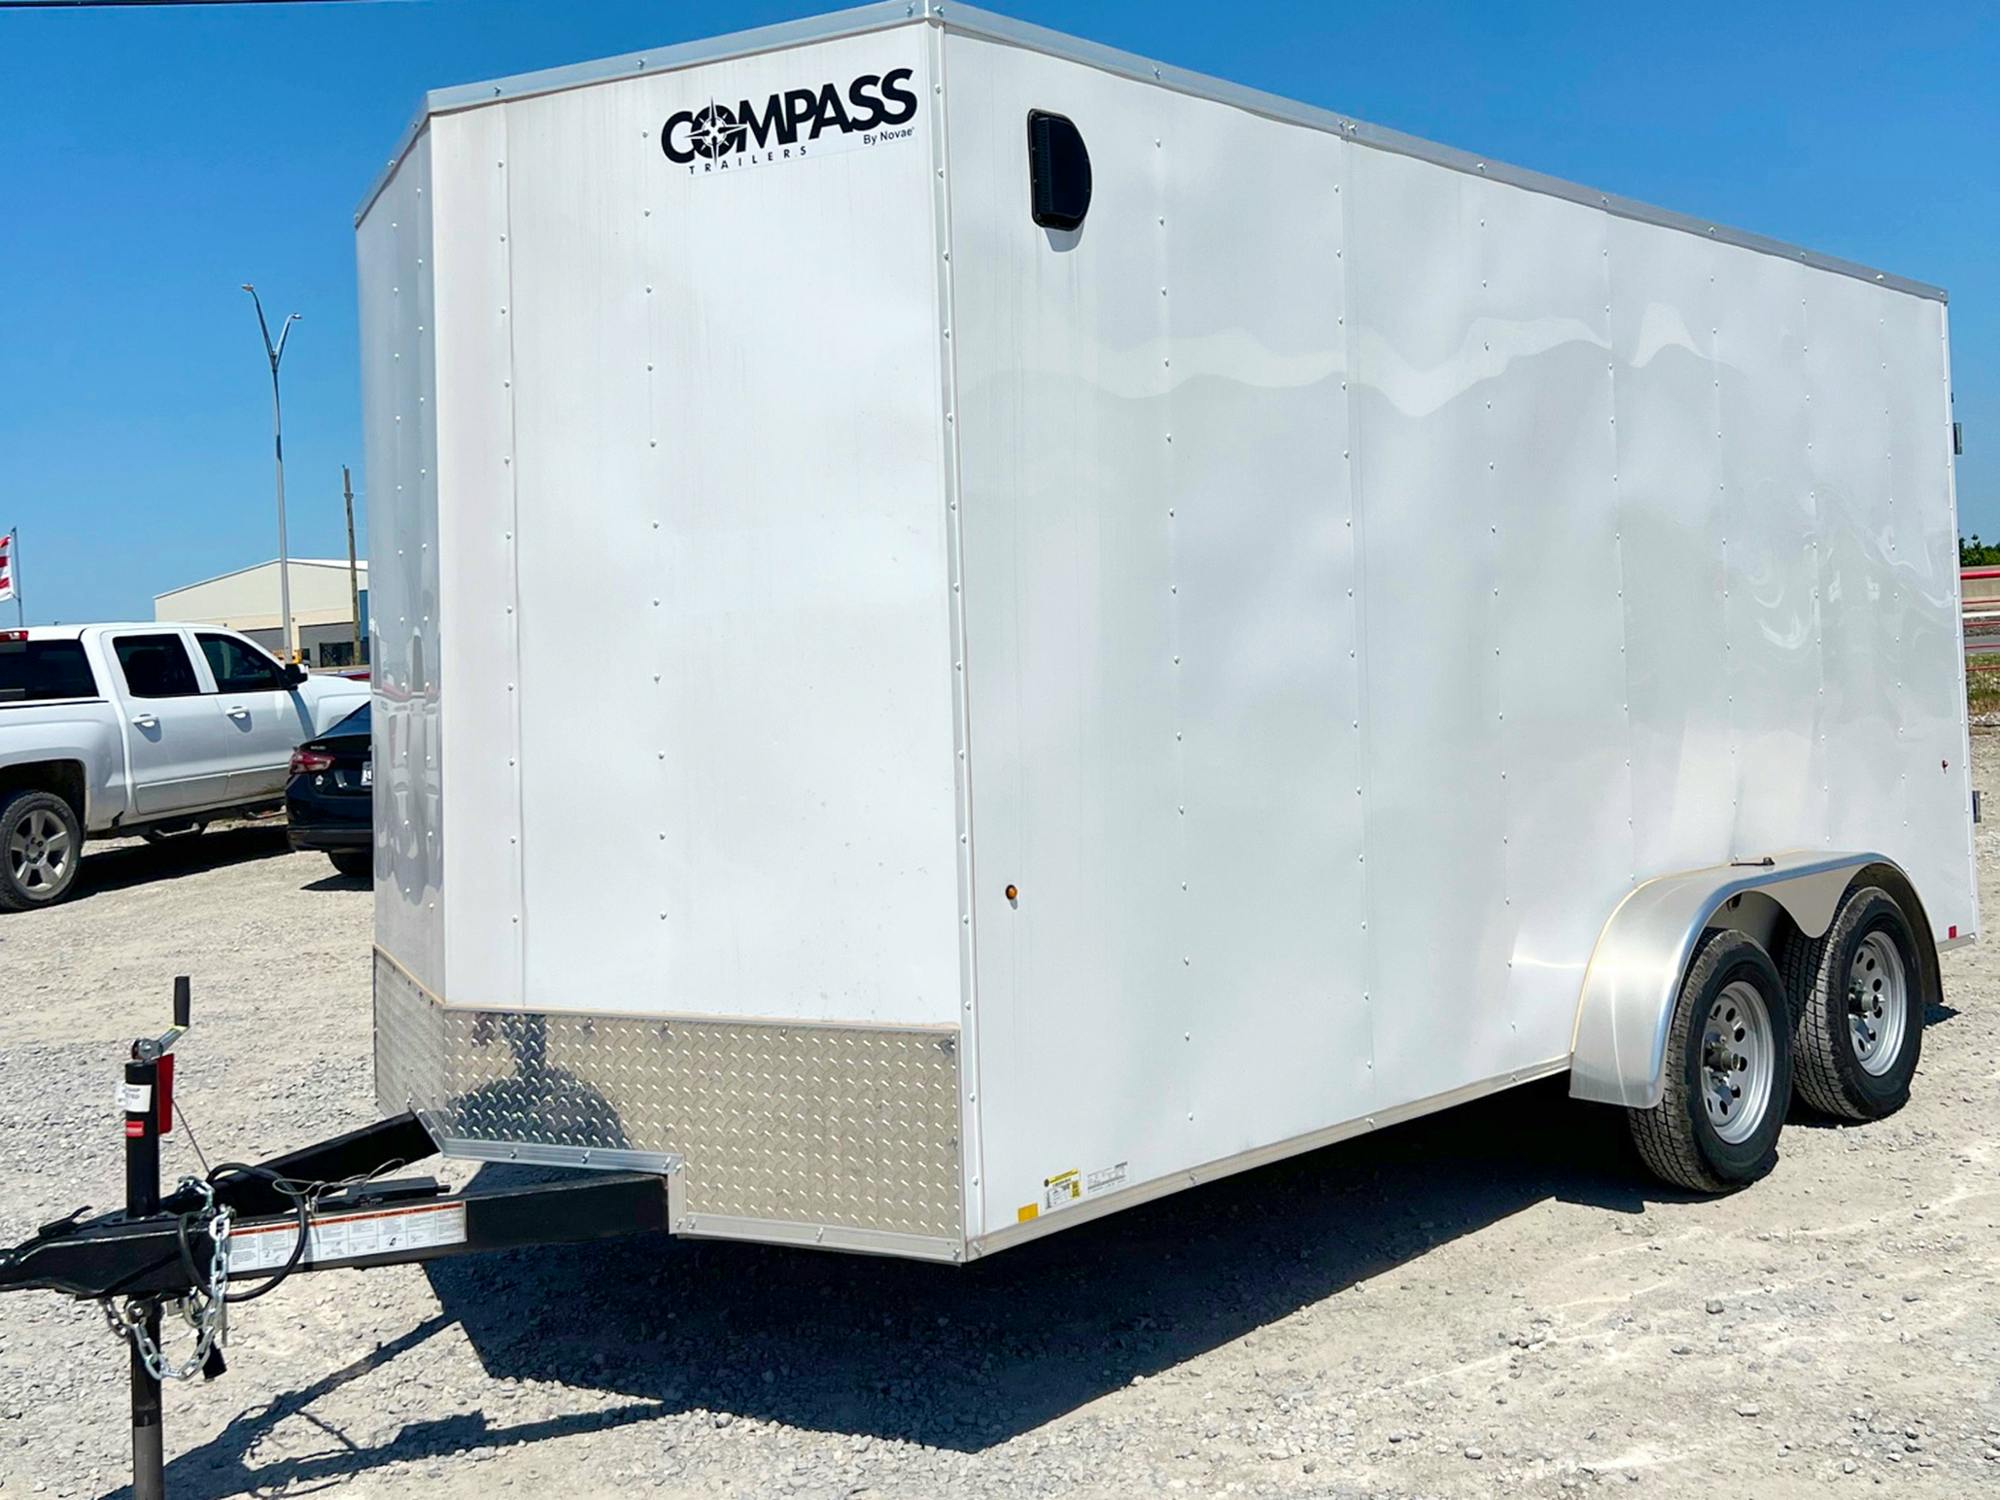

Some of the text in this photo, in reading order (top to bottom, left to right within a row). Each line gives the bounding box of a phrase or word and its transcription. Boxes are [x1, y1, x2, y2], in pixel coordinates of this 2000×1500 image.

[661, 68, 918, 164] COMPASS
[863, 134, 878, 146] By
[689, 146, 807, 175] TRAILERS
